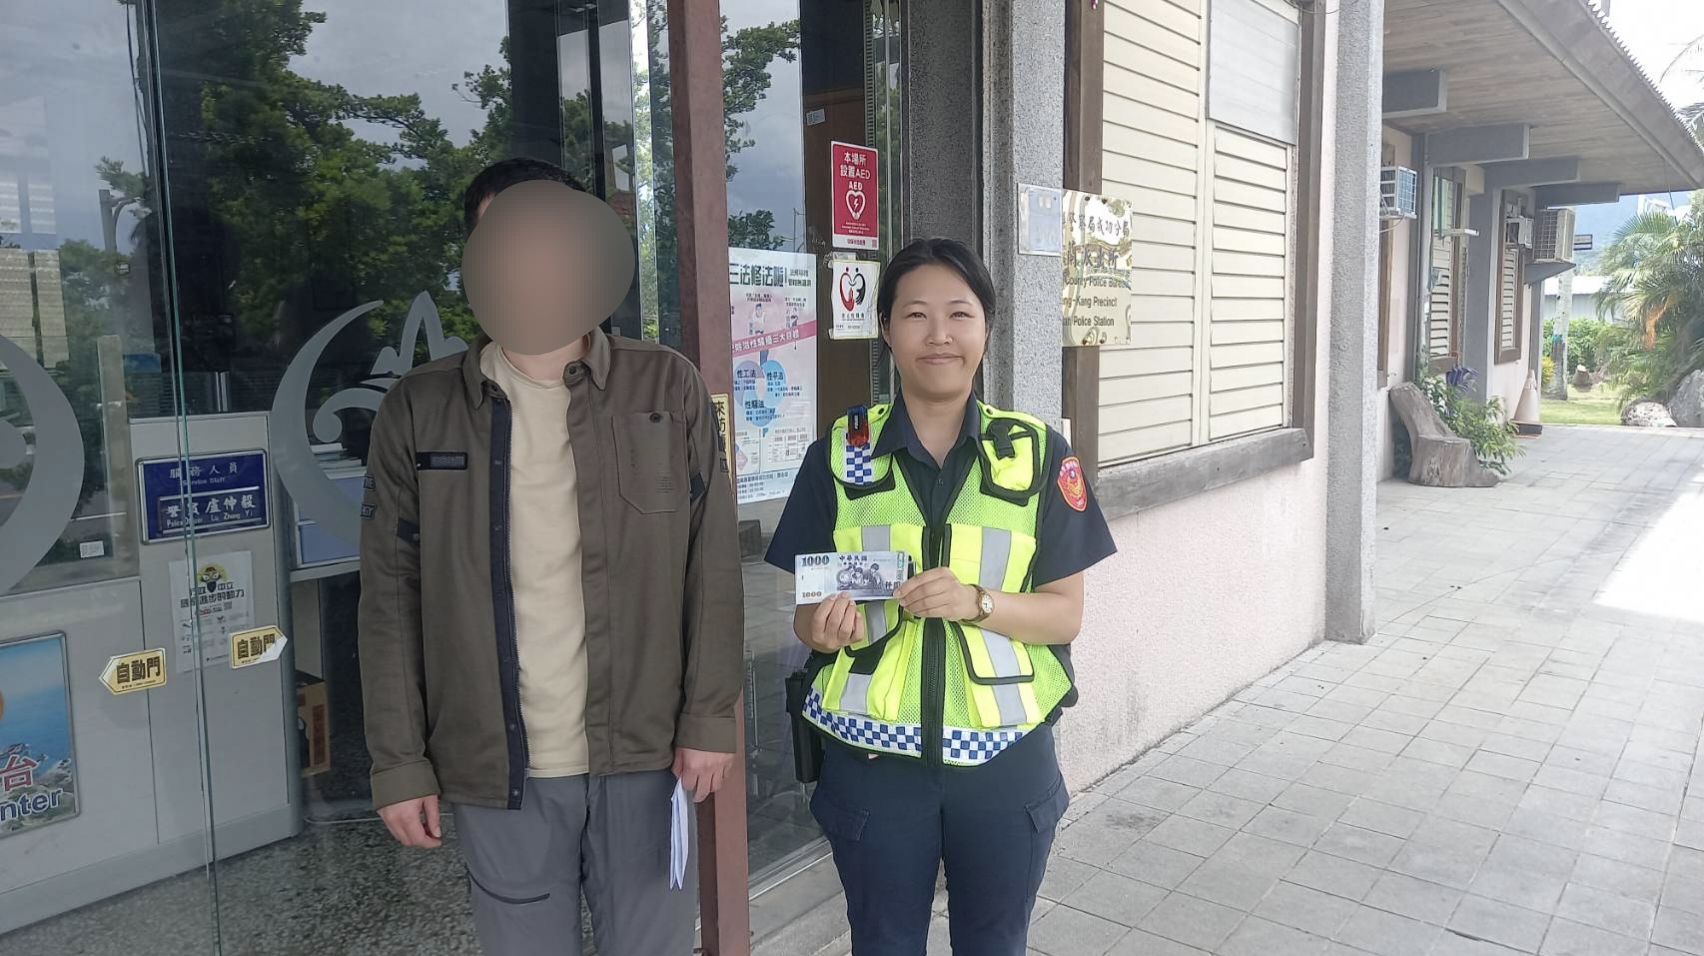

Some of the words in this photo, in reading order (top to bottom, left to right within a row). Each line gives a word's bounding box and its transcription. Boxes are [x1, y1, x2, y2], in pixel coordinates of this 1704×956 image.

[844, 152, 866, 166] 本場所
[840, 164, 870, 180] 設置AED
[848, 181, 862, 190] AED
[1089, 277, 1108, 288] Police
[1093, 296, 1117, 306] Precinct
[1074, 316, 1093, 326] Police
[1093, 316, 1114, 326] Station
[802, 555, 829, 567] 1000
[237, 634, 275, 660] 自動門
[116, 656, 160, 684] 自動門
[0, 755, 39, 791] 台
[0, 788, 62, 821] nter
